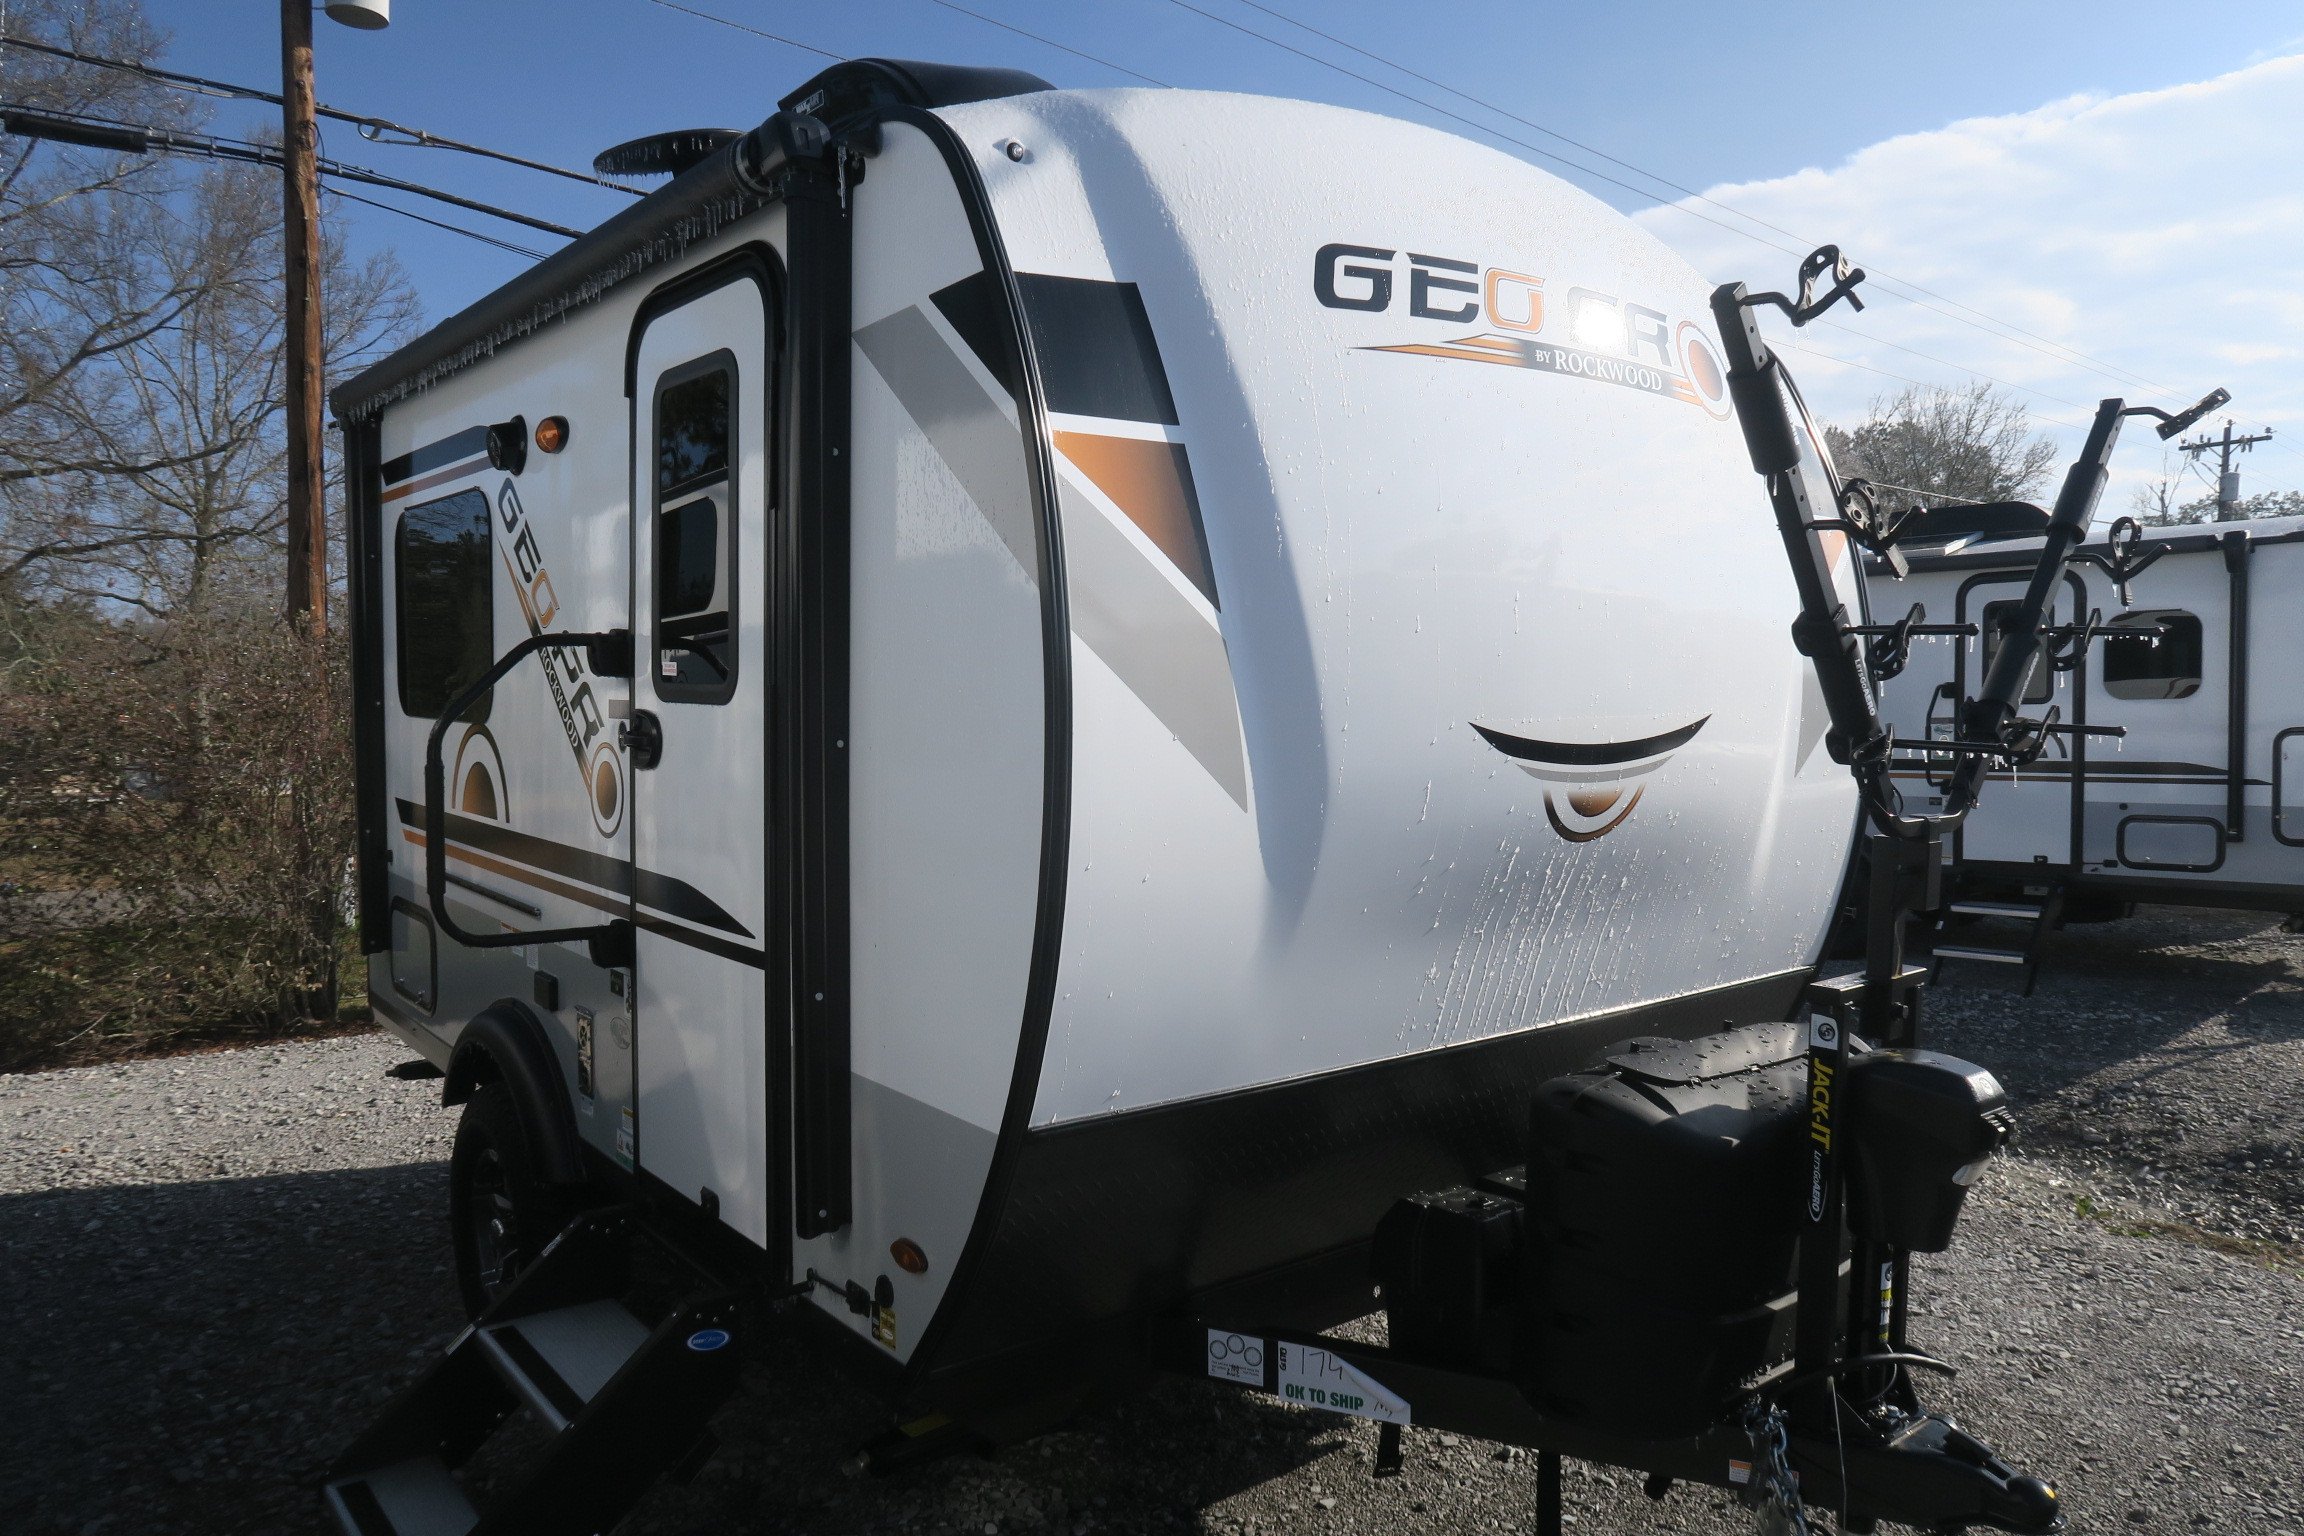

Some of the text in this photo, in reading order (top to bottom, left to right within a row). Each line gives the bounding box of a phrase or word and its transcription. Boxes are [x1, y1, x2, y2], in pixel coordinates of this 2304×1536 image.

[1314, 242, 1545, 334] GEO
[1534, 348, 1662, 392] BY ROCKWOOD
[498, 477, 560, 629] GEO
[541, 647, 579, 747] ROCKWOOD
[1811, 1057, 1834, 1152] JACK-IT
[1286, 1382, 1305, 1400] OK
[1309, 1388, 1327, 1404] TO
[1330, 1391, 1364, 1411] SHIP
